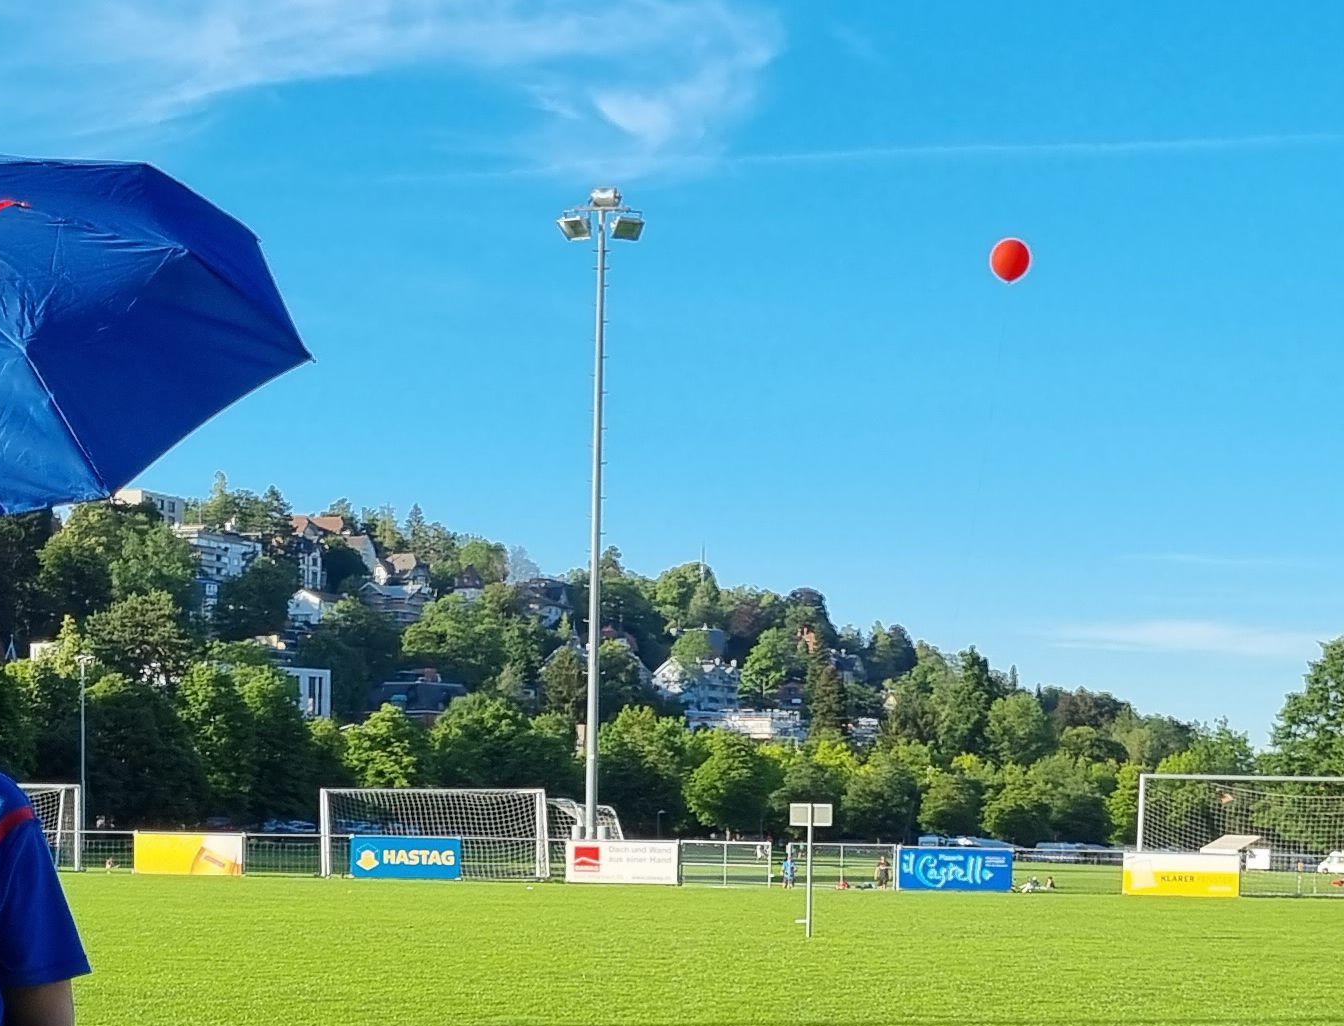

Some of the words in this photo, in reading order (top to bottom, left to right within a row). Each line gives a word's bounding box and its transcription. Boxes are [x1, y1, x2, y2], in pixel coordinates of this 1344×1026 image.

[608, 846, 629, 854] Dach
[632, 846, 646, 854] und
[649, 846, 672, 854] Wand
[382, 849, 455, 866] HASTAG
[1160, 875, 1195, 883] KLARER
